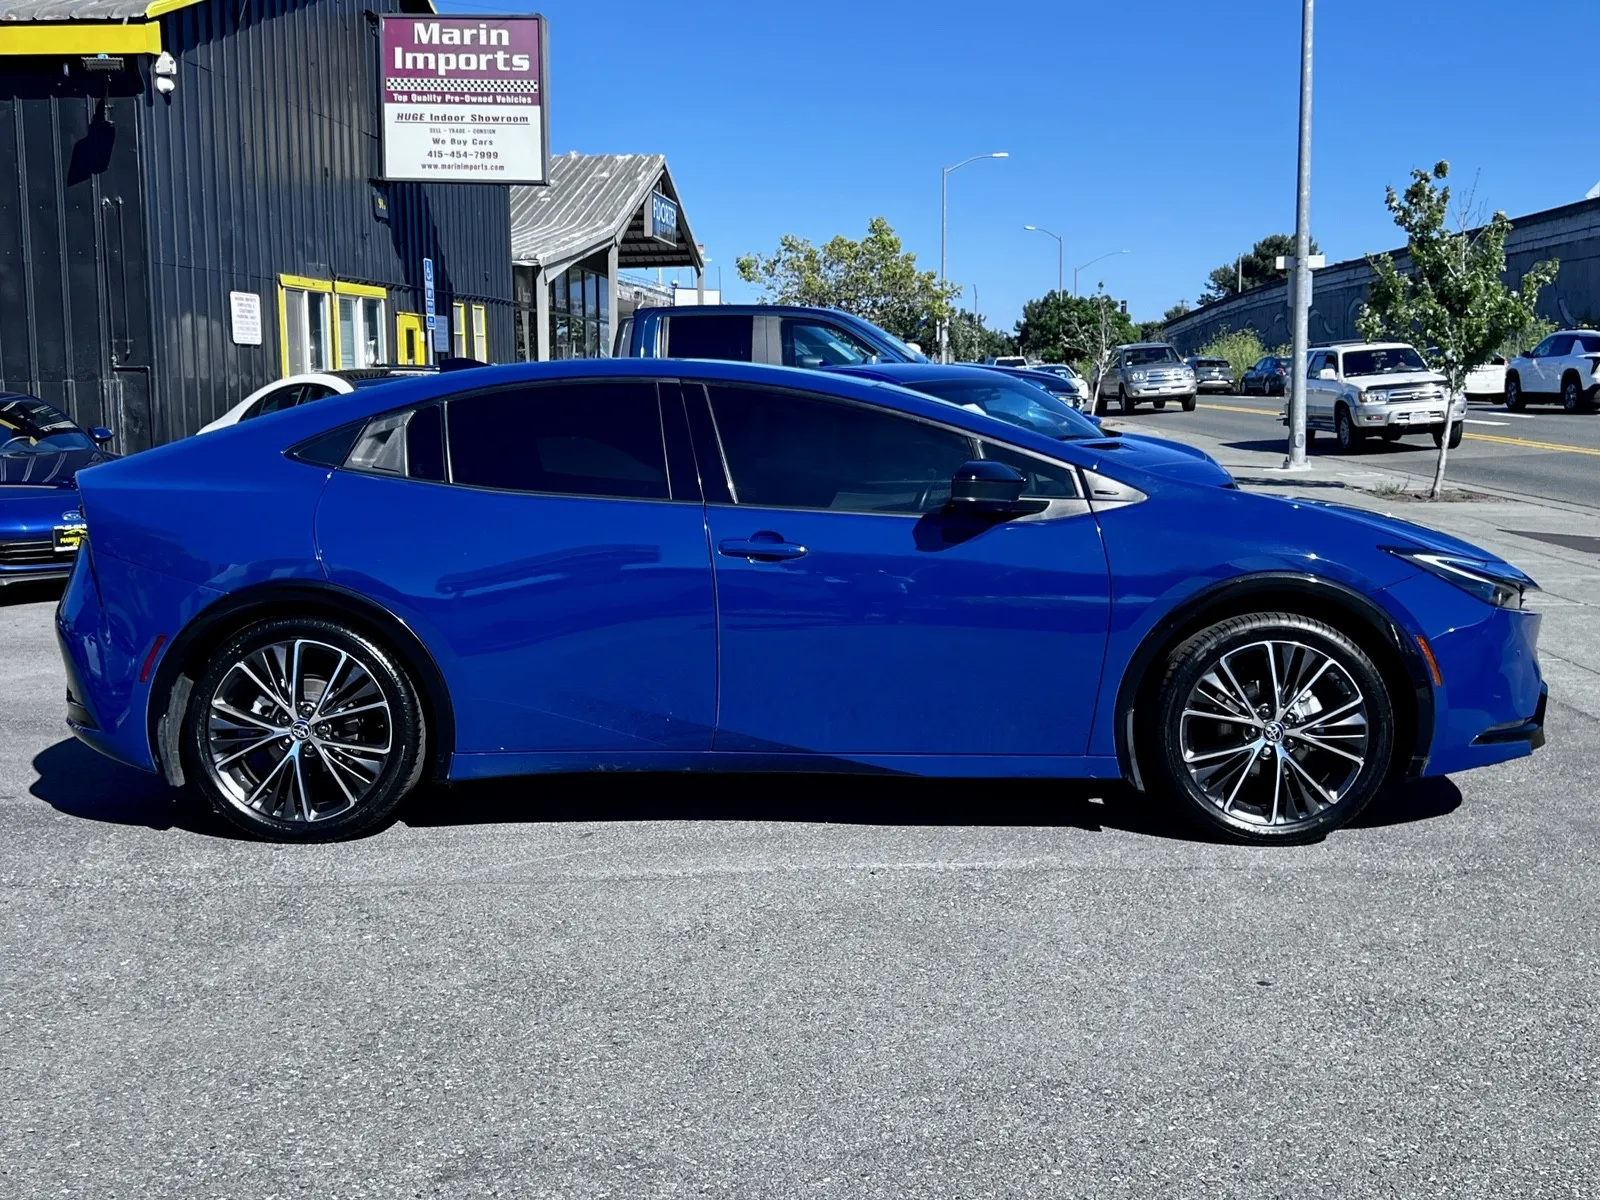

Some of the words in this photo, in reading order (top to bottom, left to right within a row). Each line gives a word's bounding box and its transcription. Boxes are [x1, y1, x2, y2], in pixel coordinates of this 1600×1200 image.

[413, 22, 510, 45] Marin
[394, 46, 530, 76] Imports
[393, 93, 408, 102] Top
[410, 93, 442, 103] Quality
[445, 94, 493, 104] Pre-Owned
[496, 95, 532, 104] Vehicles
[396, 112, 426, 122] HUGE
[429, 113, 466, 122] Indoor
[470, 114, 529, 123] Showroom
[431, 137, 446, 145] We
[450, 138, 468, 147] Buy
[471, 138, 494, 146] Cars
[426, 150, 499, 159] 415-454-7999
[420, 162, 505, 171] www.marinimports.com
